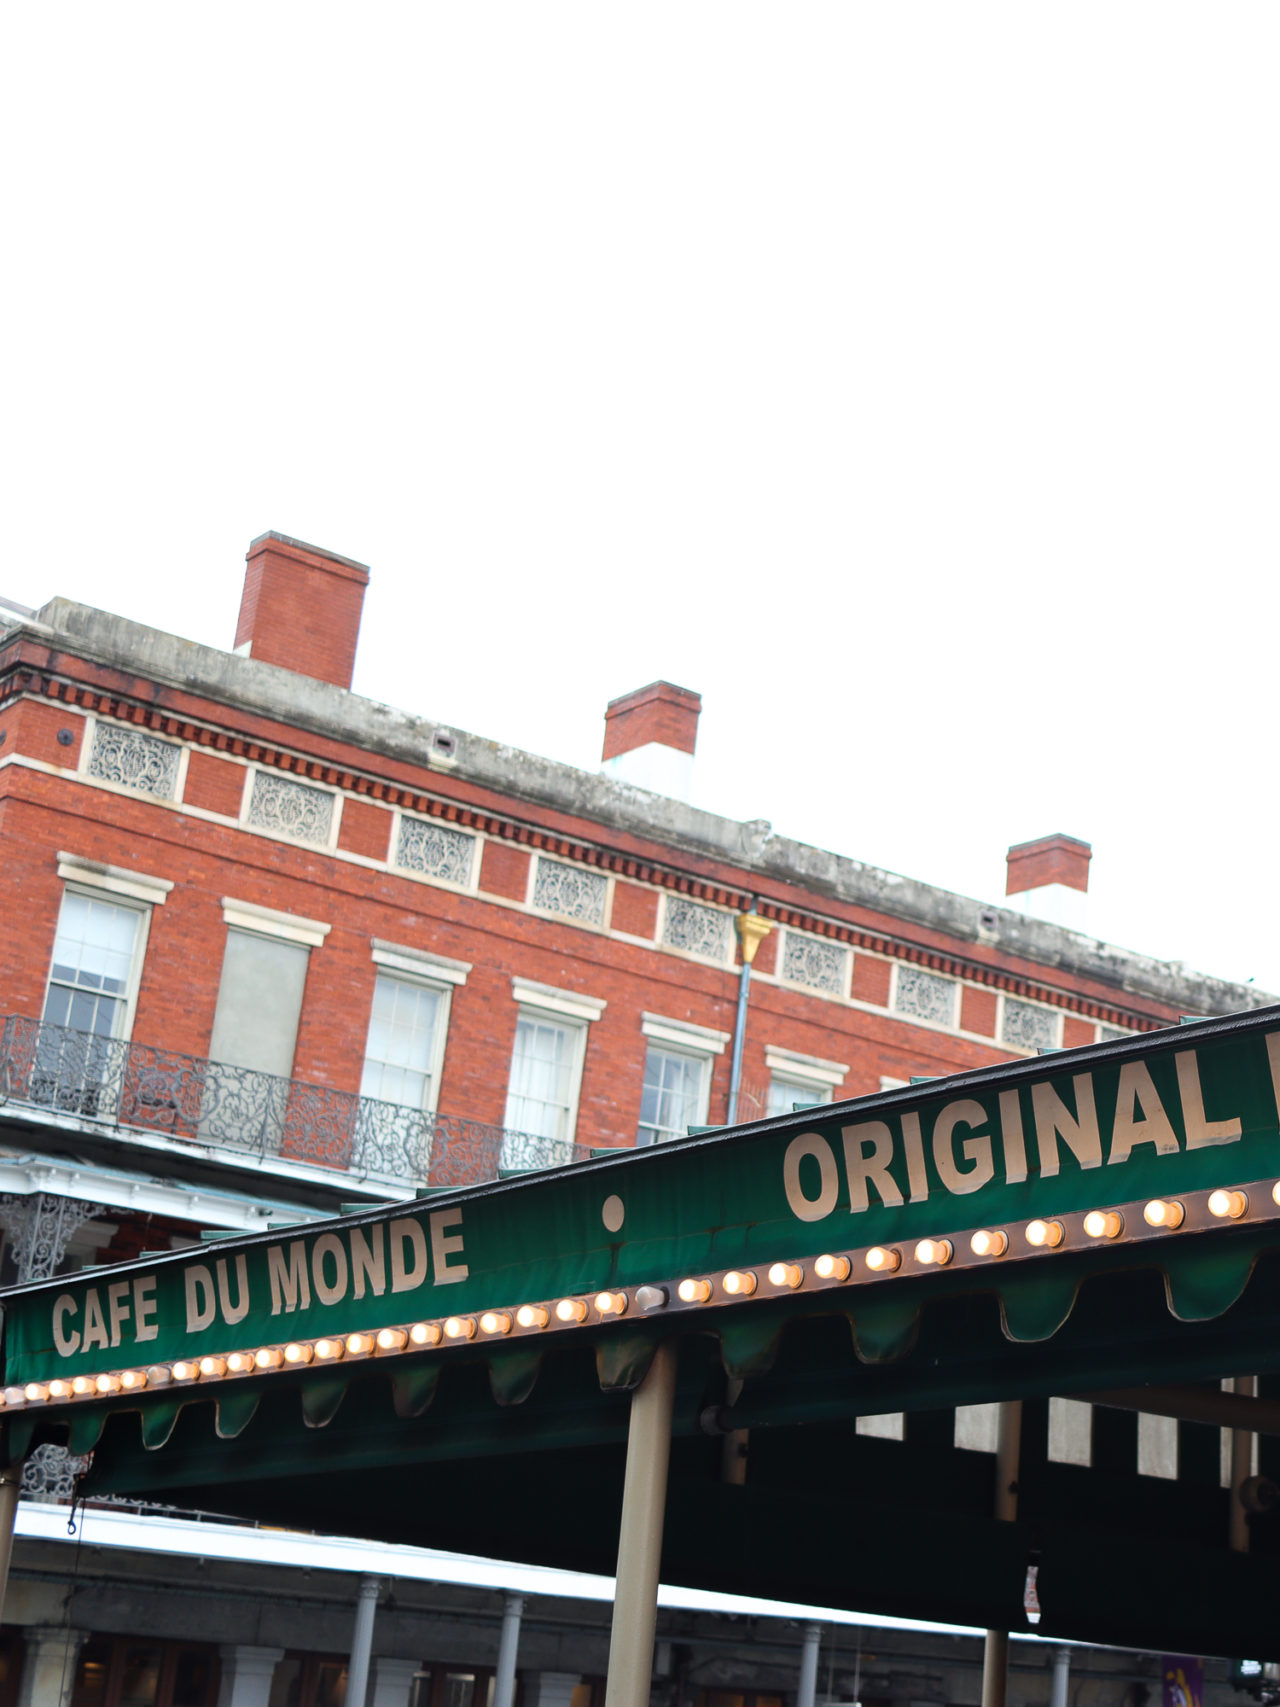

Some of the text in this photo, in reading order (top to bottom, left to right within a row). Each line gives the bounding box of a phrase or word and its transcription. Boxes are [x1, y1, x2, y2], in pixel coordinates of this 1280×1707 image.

[53, 1276, 159, 1357] CAFE
[184, 1254, 250, 1333] DU
[267, 1207, 470, 1315] MONDE
[783, 1049, 1243, 1223] ORIGINAL
